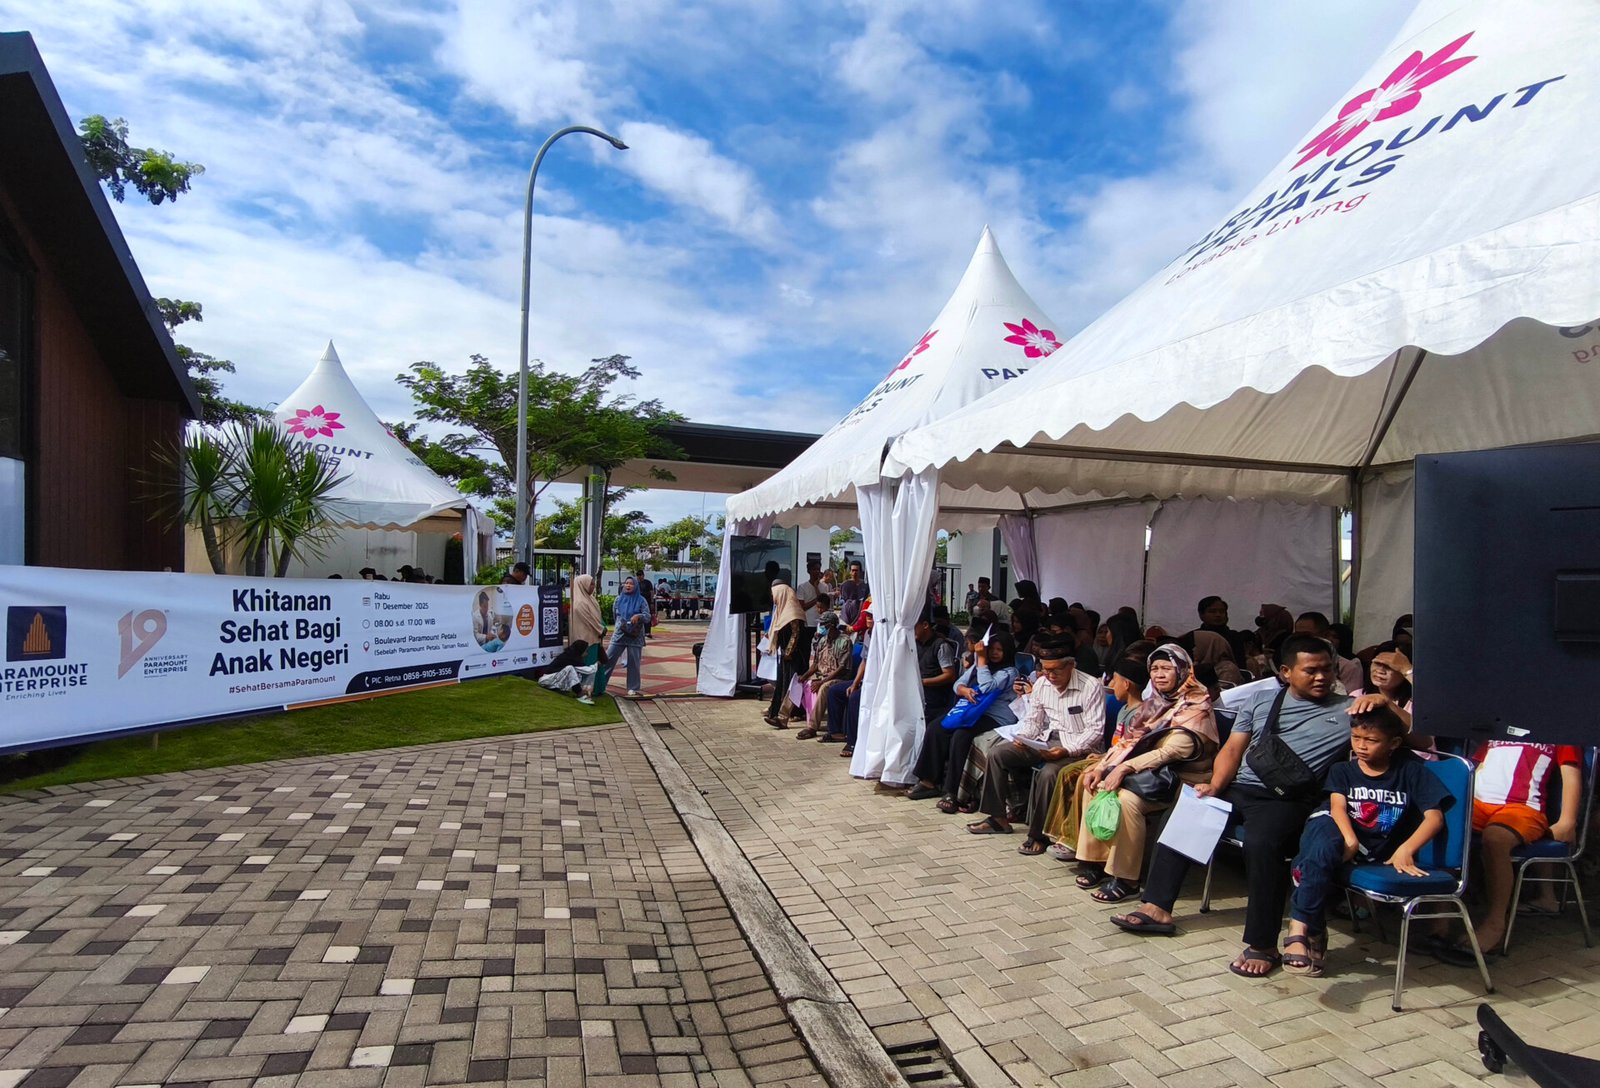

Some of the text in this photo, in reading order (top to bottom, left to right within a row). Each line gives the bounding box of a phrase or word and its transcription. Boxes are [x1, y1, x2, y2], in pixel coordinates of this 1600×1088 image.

[1184, 154, 1405, 265] PETALS
[1266, 192, 1371, 236] Living
[232, 588, 331, 612] Khitanan
[375, 592, 390, 600] Rabu
[383, 602, 413, 610] Desember
[416, 602, 429, 610] 2025
[219, 616, 341, 644] Sehat Bagi
[375, 636, 407, 645] Boulevard
[408, 634, 440, 643] Paramount
[399, 645, 425, 654] Paramount
[143, 659, 188, 668] PARAMOUNT
[209, 643, 349, 677] Anak Negeri
[0, 663, 88, 681] RAMOUNT
[143, 666, 188, 675] ENTERPRISE
[0, 675, 88, 693] TERPRISE
[229, 675, 336, 694] #SehatBersamaParamount
[6, 691, 46, 701] Enriching
